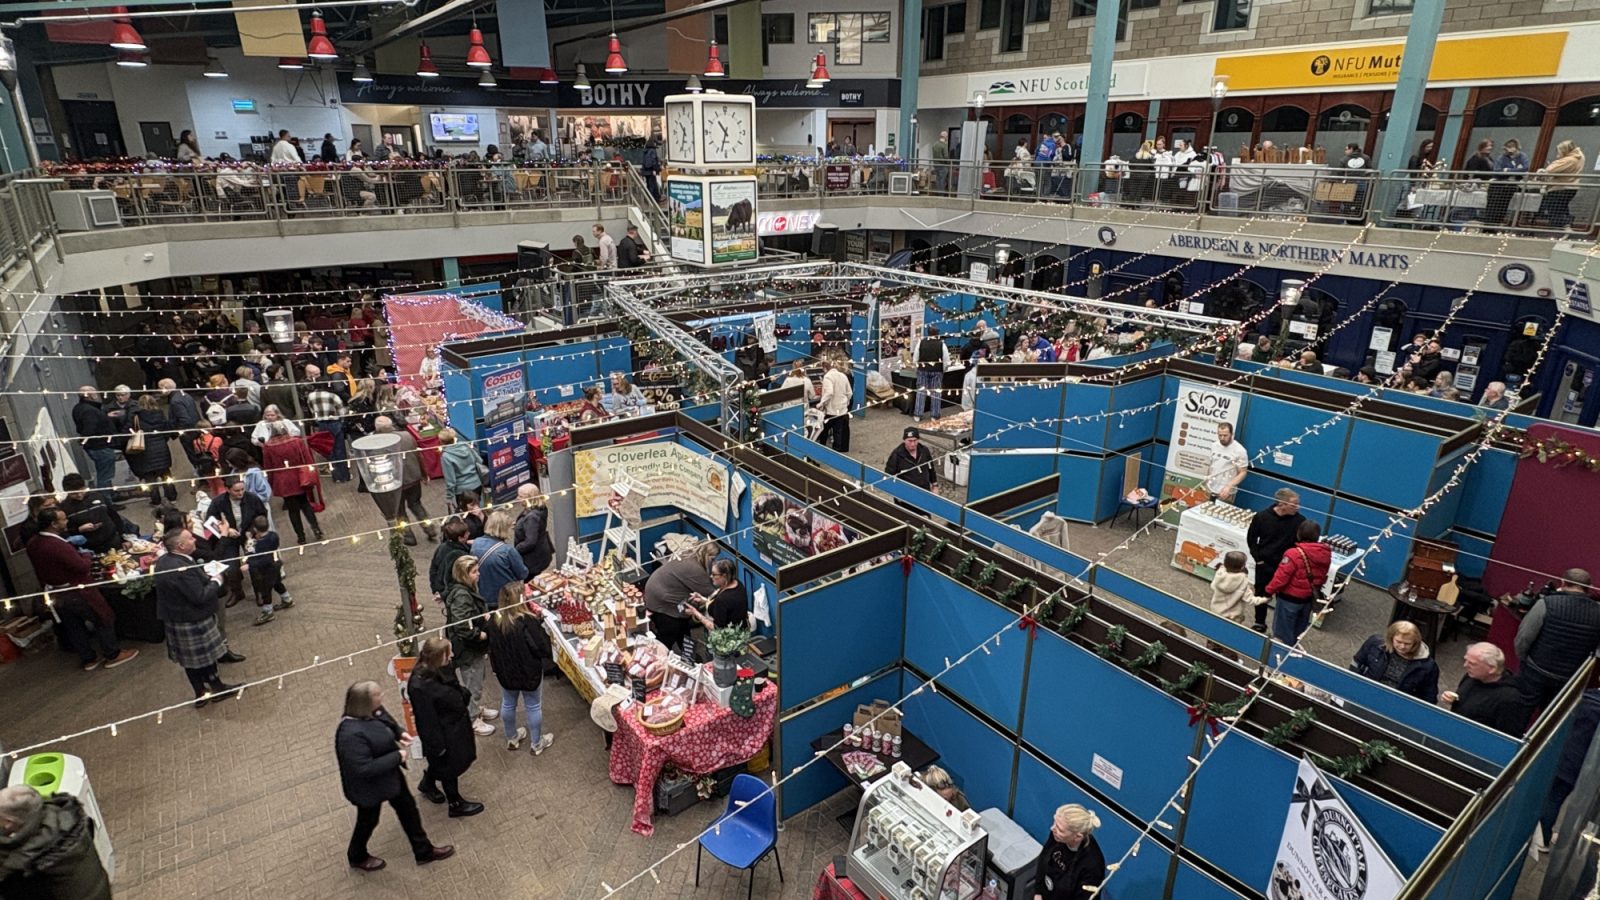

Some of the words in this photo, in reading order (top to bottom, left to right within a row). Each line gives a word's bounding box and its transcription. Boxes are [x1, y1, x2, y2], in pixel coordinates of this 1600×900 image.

[1334, 57, 1366, 71] NFU
[1369, 54, 1401, 69] Mut
[1019, 78, 1051, 93] NFU
[1054, 73, 1117, 91] Scotld
[581, 83, 650, 107] BOTHY
[841, 93, 862, 101] BOTHY
[1168, 234, 1239, 253] ABERDEEN
[1243, 242, 1255, 254] &
[1258, 243, 1344, 263] NORTHERN
[1349, 250, 1410, 270] MARTS
[485, 369, 523, 388] COSTCO
[607, 448, 667, 464] Cloverlea
[1323, 810, 1366, 872] DUNNOTTAR
